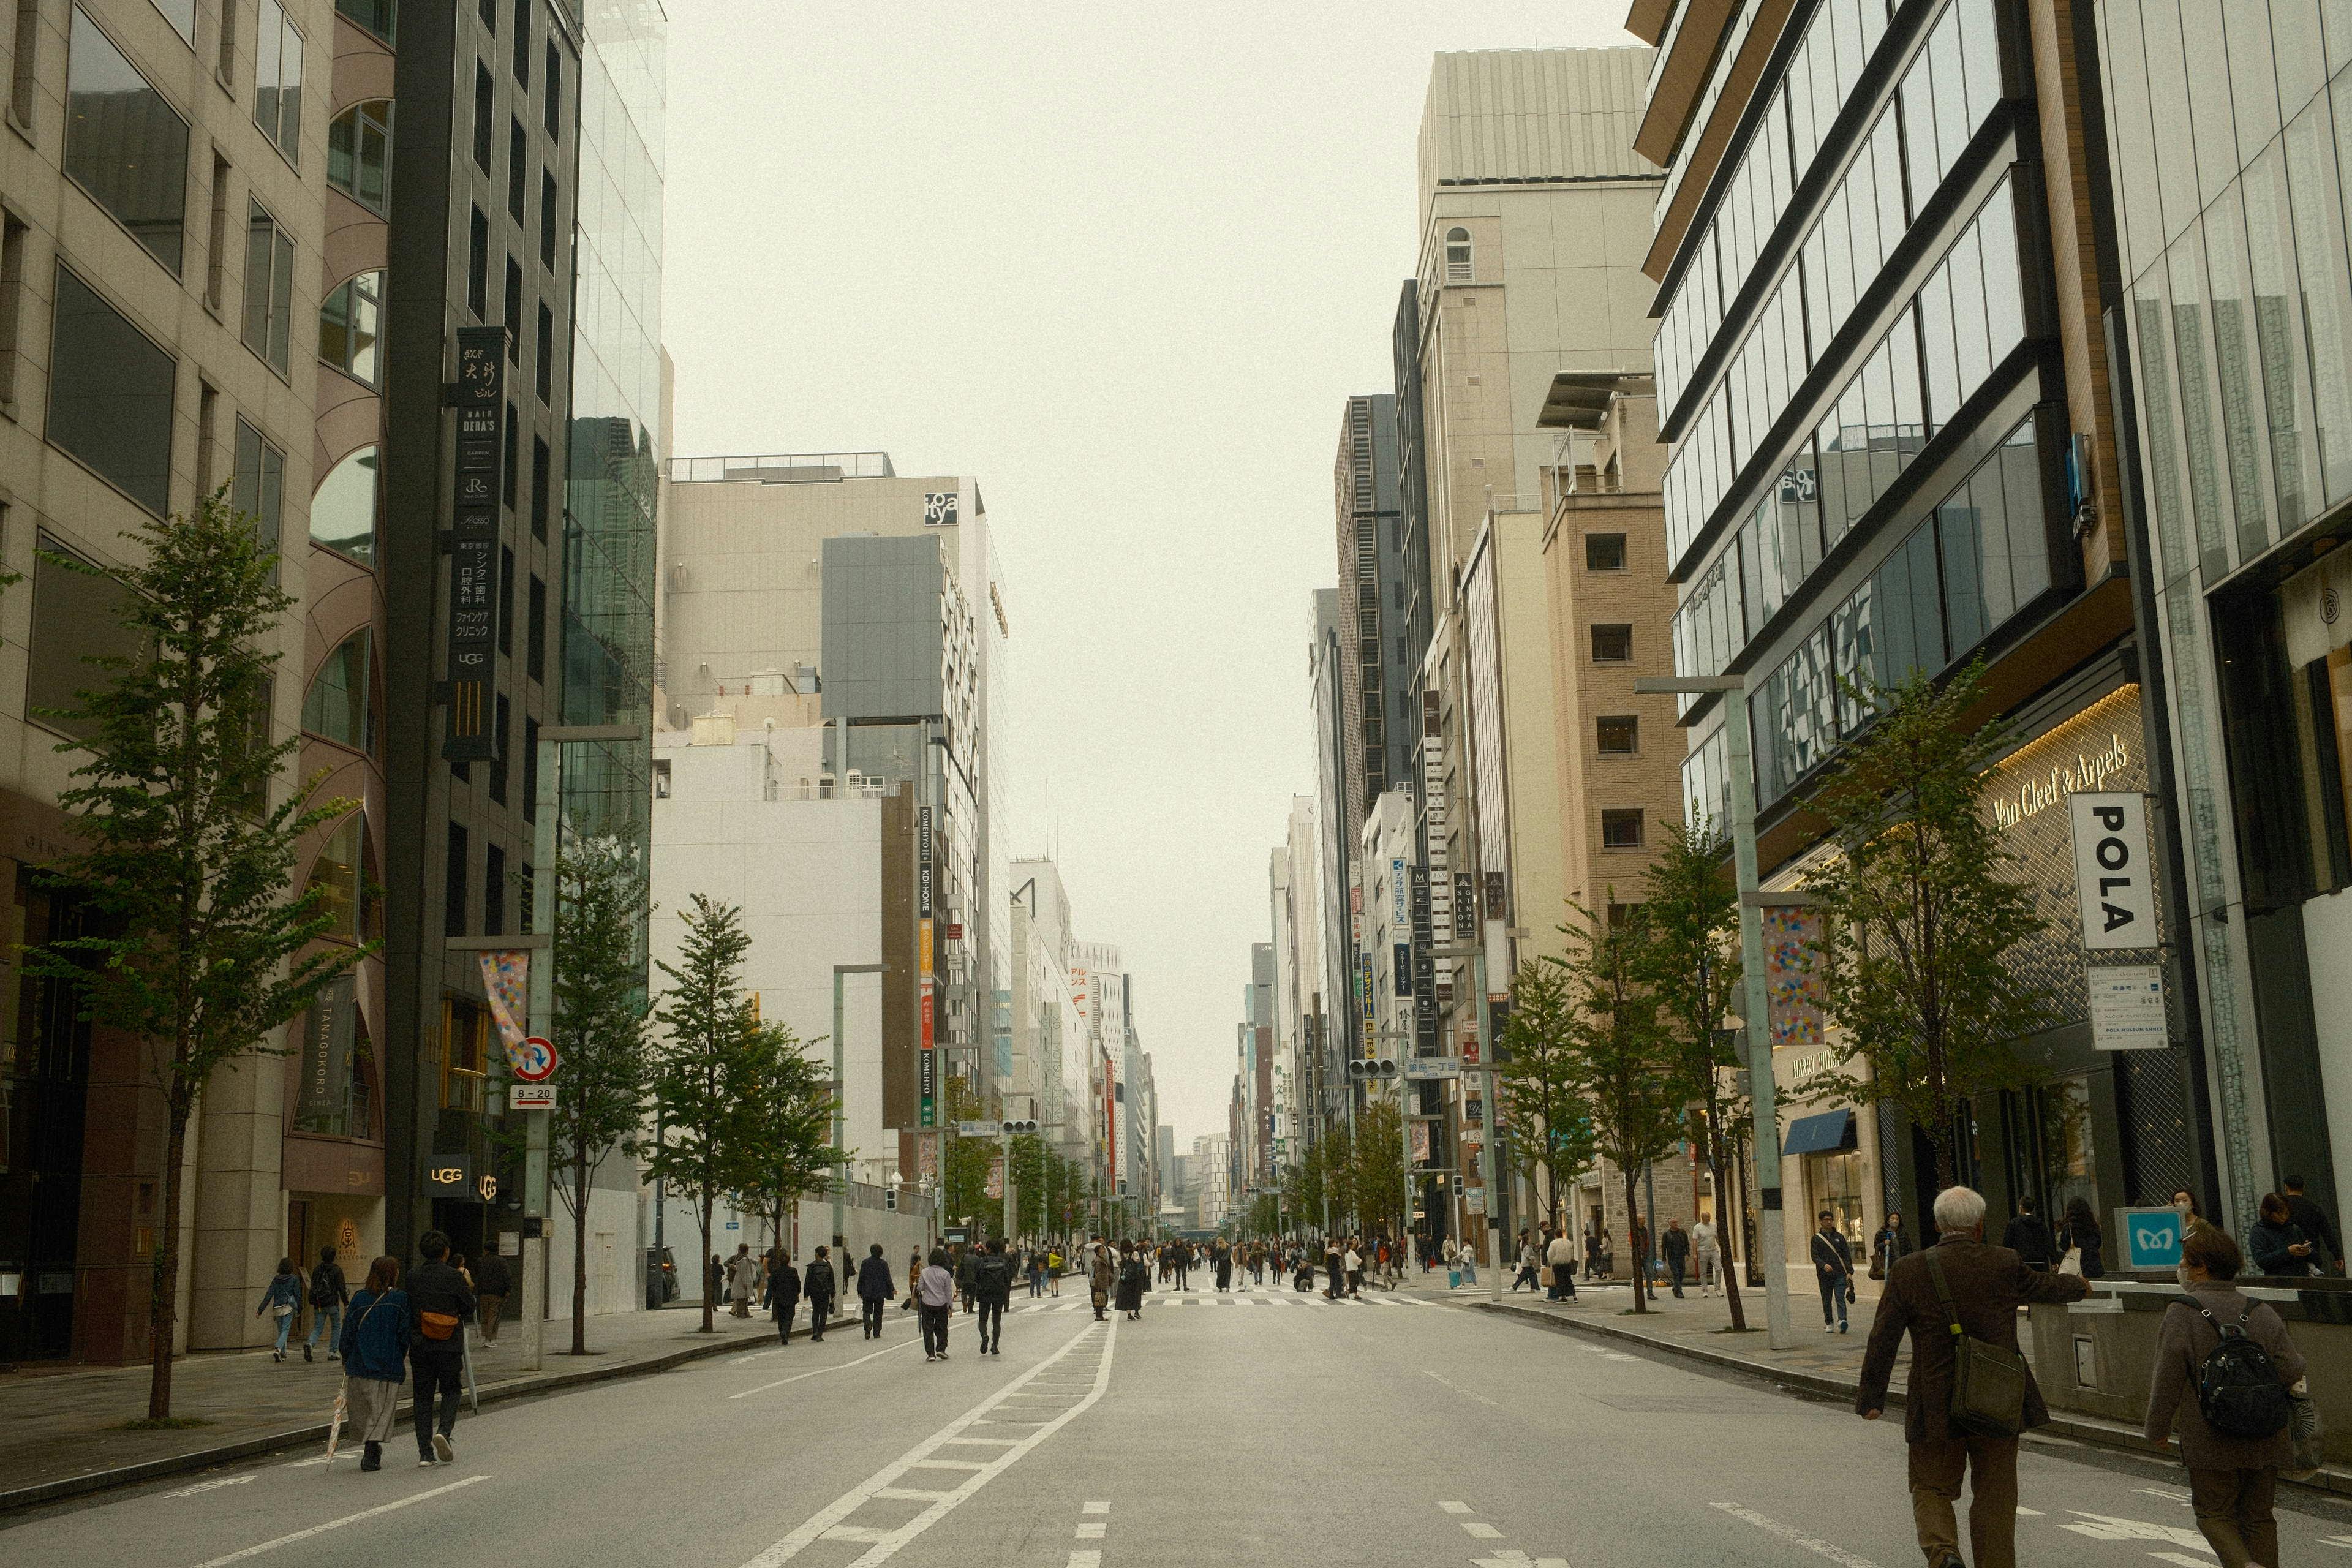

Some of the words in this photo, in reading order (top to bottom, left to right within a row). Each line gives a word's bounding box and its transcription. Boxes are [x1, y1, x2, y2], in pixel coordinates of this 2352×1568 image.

[474, 388, 496, 398] ビル
[464, 420, 495, 432] DERA'S
[461, 567, 472, 605] 口腔外科
[475, 552, 488, 605] シンタニ歯科
[456, 612, 488, 623] ファインケア
[456, 626, 488, 637] クリニック
[459, 653, 484, 665] UGG
[1994, 797, 2020, 831] Van
[2019, 767, 2057, 818] Cleef
[2062, 771, 2073, 796] &
[2075, 734, 2127, 791] Arpels
[2092, 806, 2135, 933] POLA
[315, 1008, 332, 1094] TANAGOKORO
[1409, 1061, 1456, 1072] 銀座一丁目
[1792, 1054, 1815, 1079] HARRY
[431, 1168, 462, 1183] UGG
[480, 1175, 497, 1200] UGG
